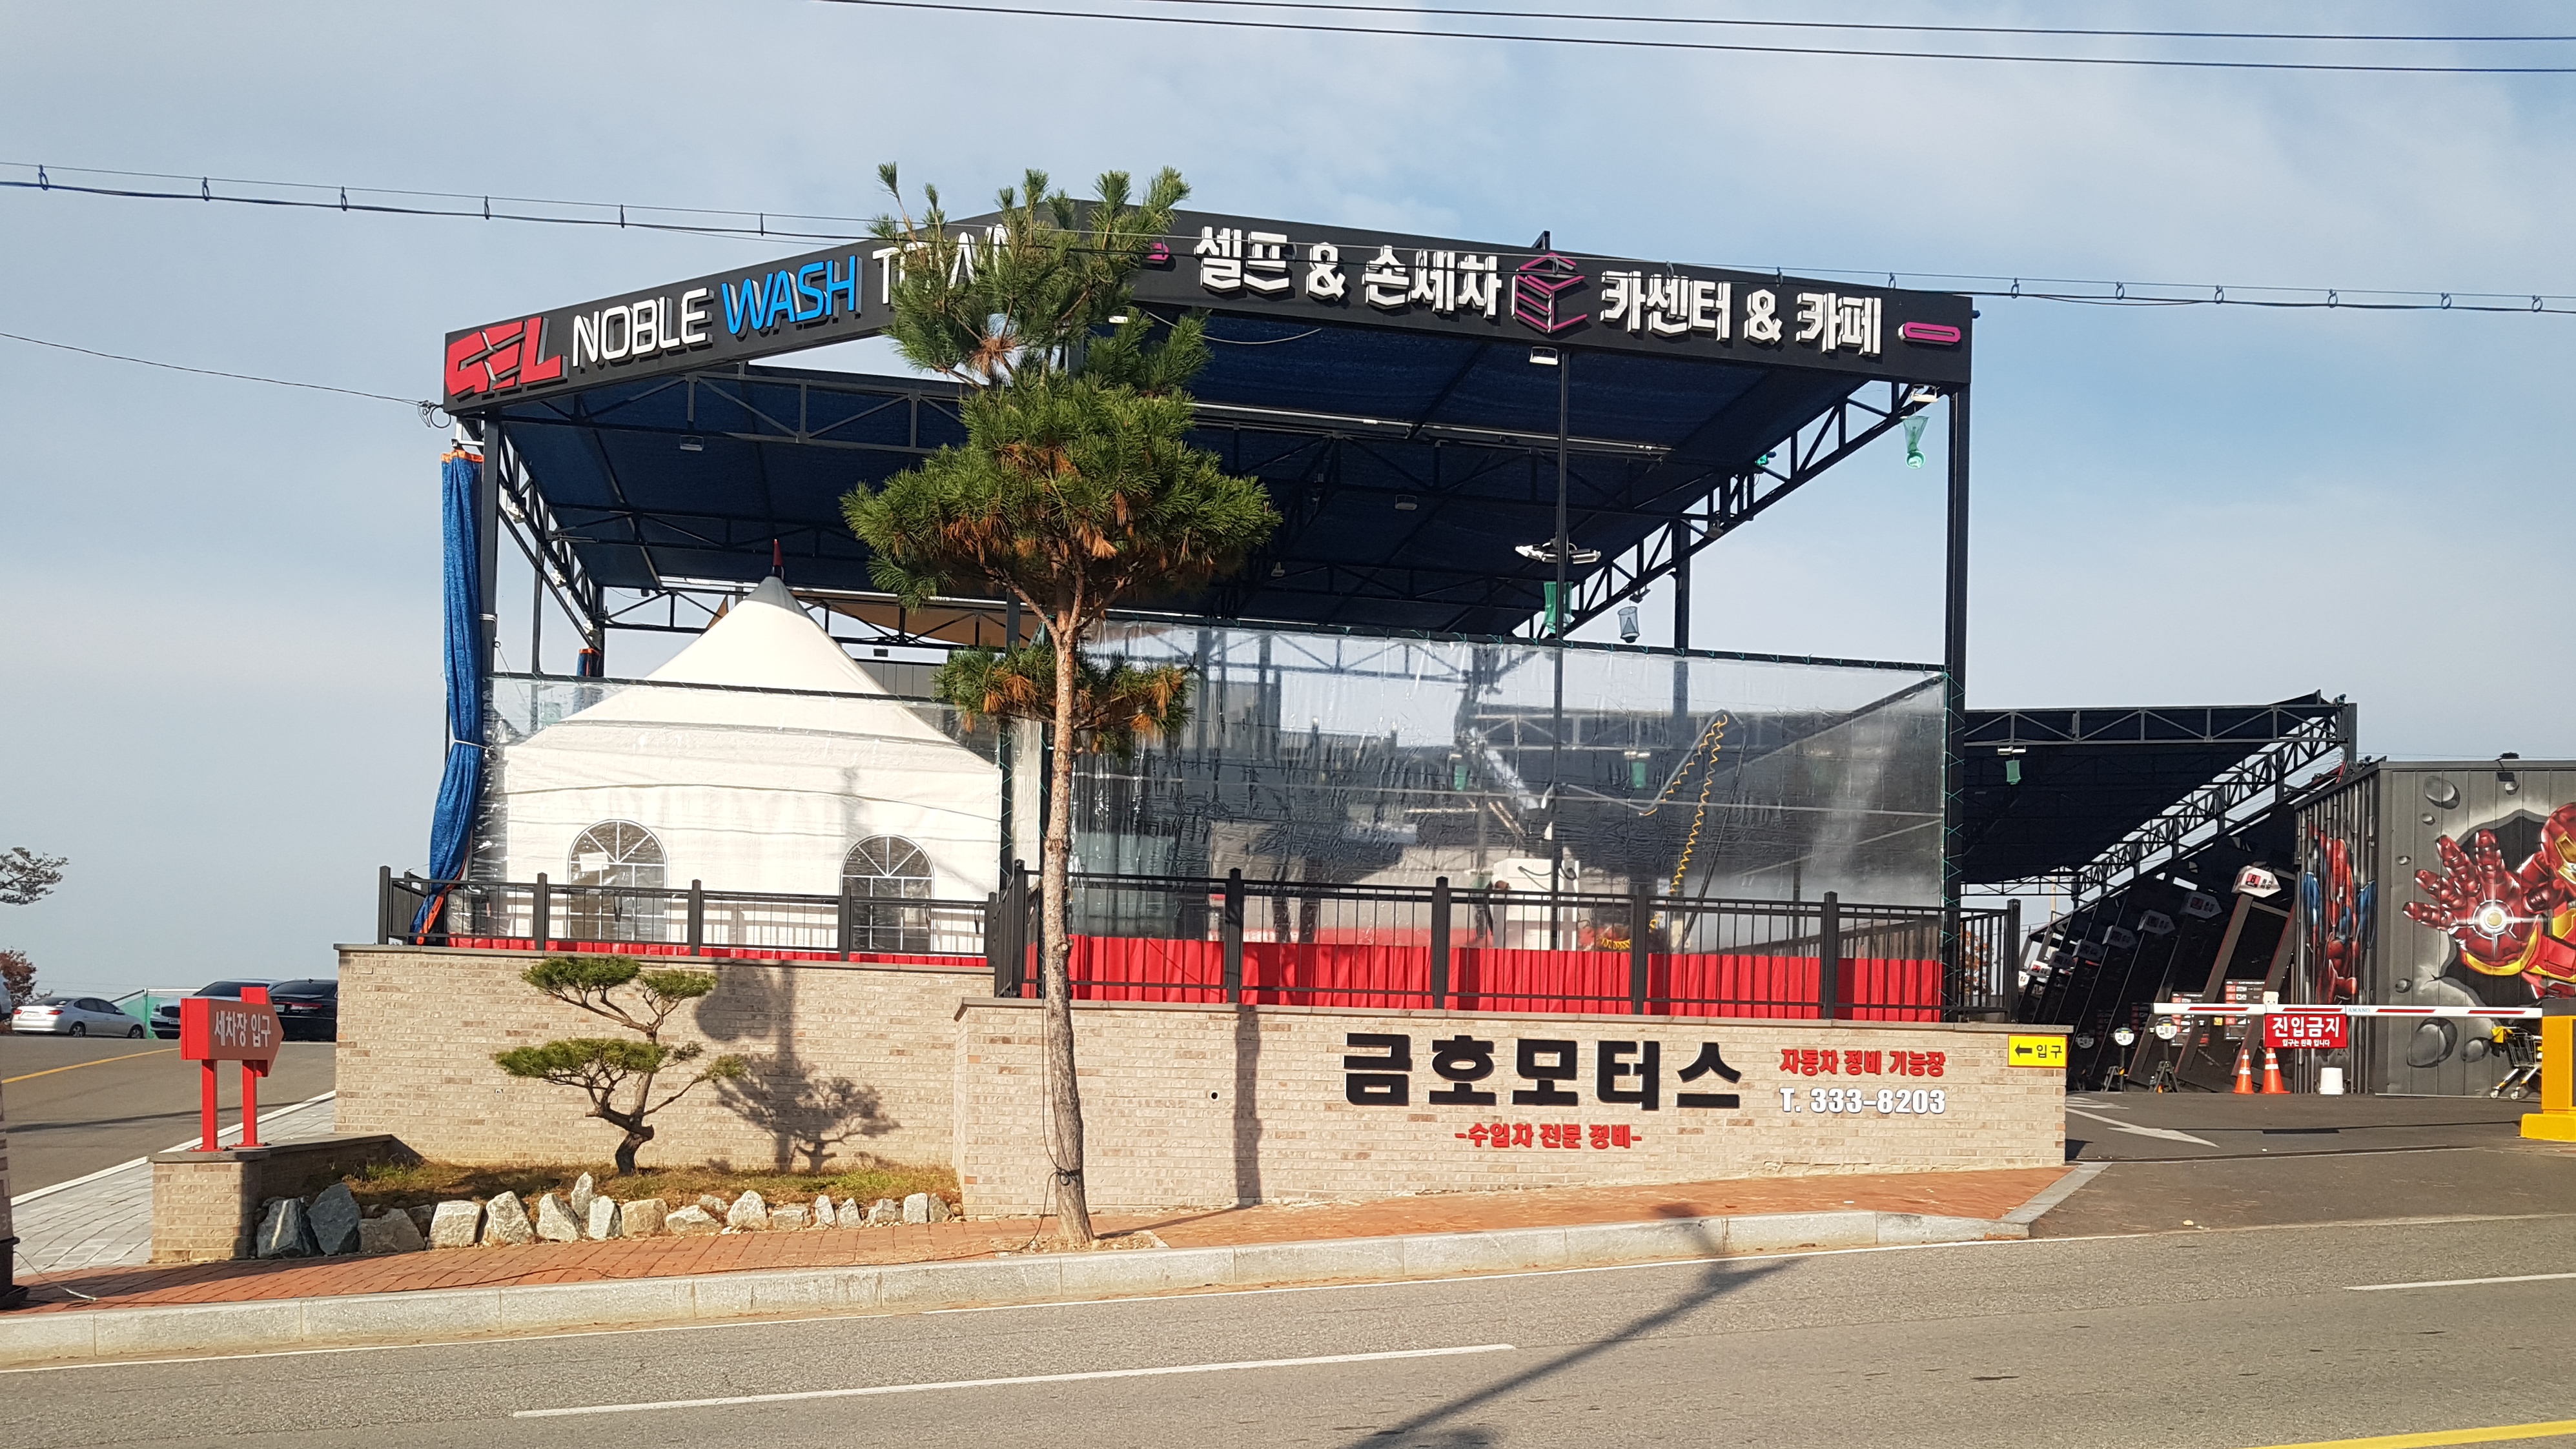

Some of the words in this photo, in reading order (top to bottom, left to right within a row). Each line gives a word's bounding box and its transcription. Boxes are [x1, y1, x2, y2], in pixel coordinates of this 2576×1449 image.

[1195, 226, 1290, 293] 셀프
[1307, 241, 1346, 299] &
[1362, 245, 1503, 319] 손세차
[572, 288, 709, 368] NOBLE
[721, 254, 859, 336] WASH
[1600, 270, 1732, 341] 카센터
[1744, 289, 1783, 344] &
[1797, 292, 1882, 356] 카페
[214, 1010, 248, 1048] 세차장
[250, 1013, 271, 1048] 입구
[2272, 1017, 2340, 1038] 진입금지
[1779, 1048, 1838, 1076] 자동차
[1844, 1050, 1881, 1075] 정비
[1888, 1051, 1946, 1077] 기능장
[2036, 1044, 2063, 1059] 입구
[1344, 1033, 1742, 1111] 금호모터스
[1780, 1088, 1801, 1112] T.
[1810, 1088, 1946, 1115] 333-8203
[1539, 1124, 1581, 1148] 전문
